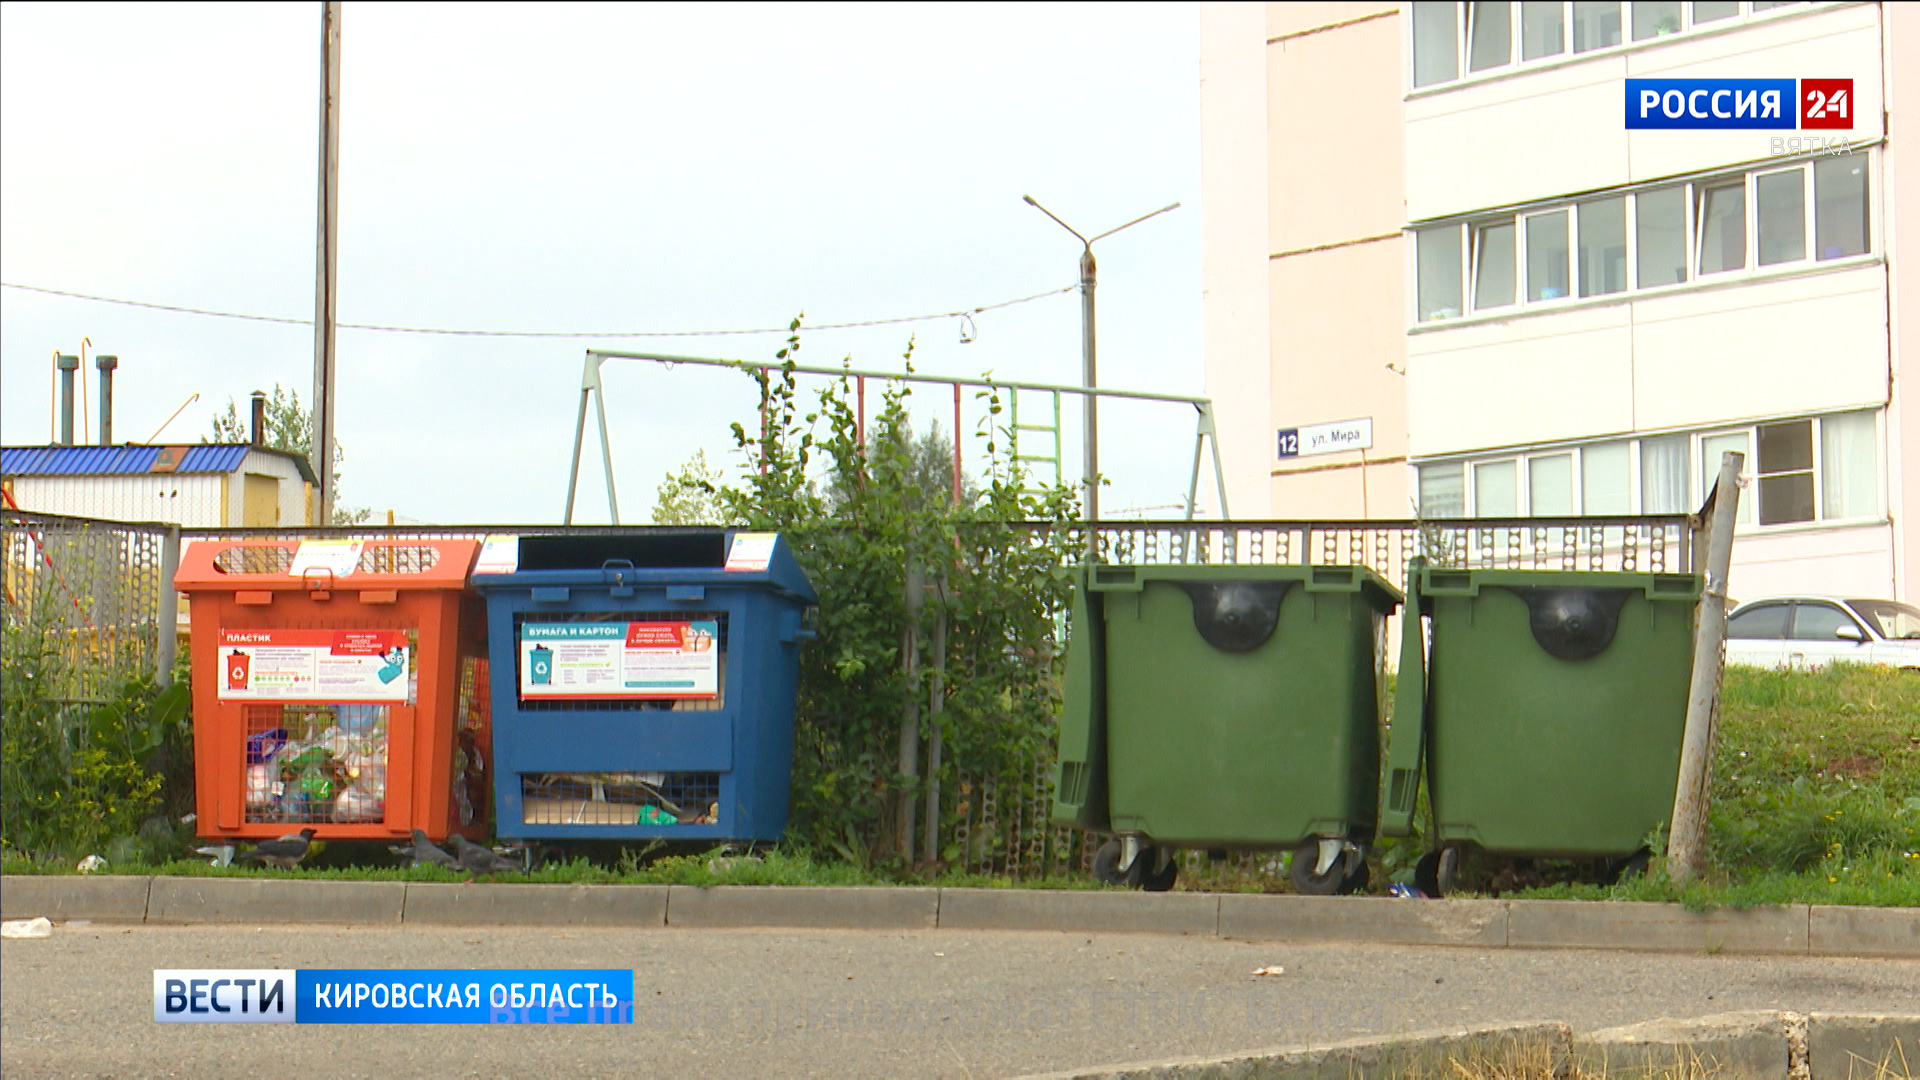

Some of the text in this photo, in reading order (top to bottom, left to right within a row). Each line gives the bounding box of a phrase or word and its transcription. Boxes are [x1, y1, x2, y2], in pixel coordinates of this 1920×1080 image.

[1280, 434, 1298, 454] 12
[1311, 429, 1361, 448] ул. Мира
[226, 633, 272, 642] ПЛАСТИК
[529, 626, 619, 636] БУМАГА И КАРТОН
